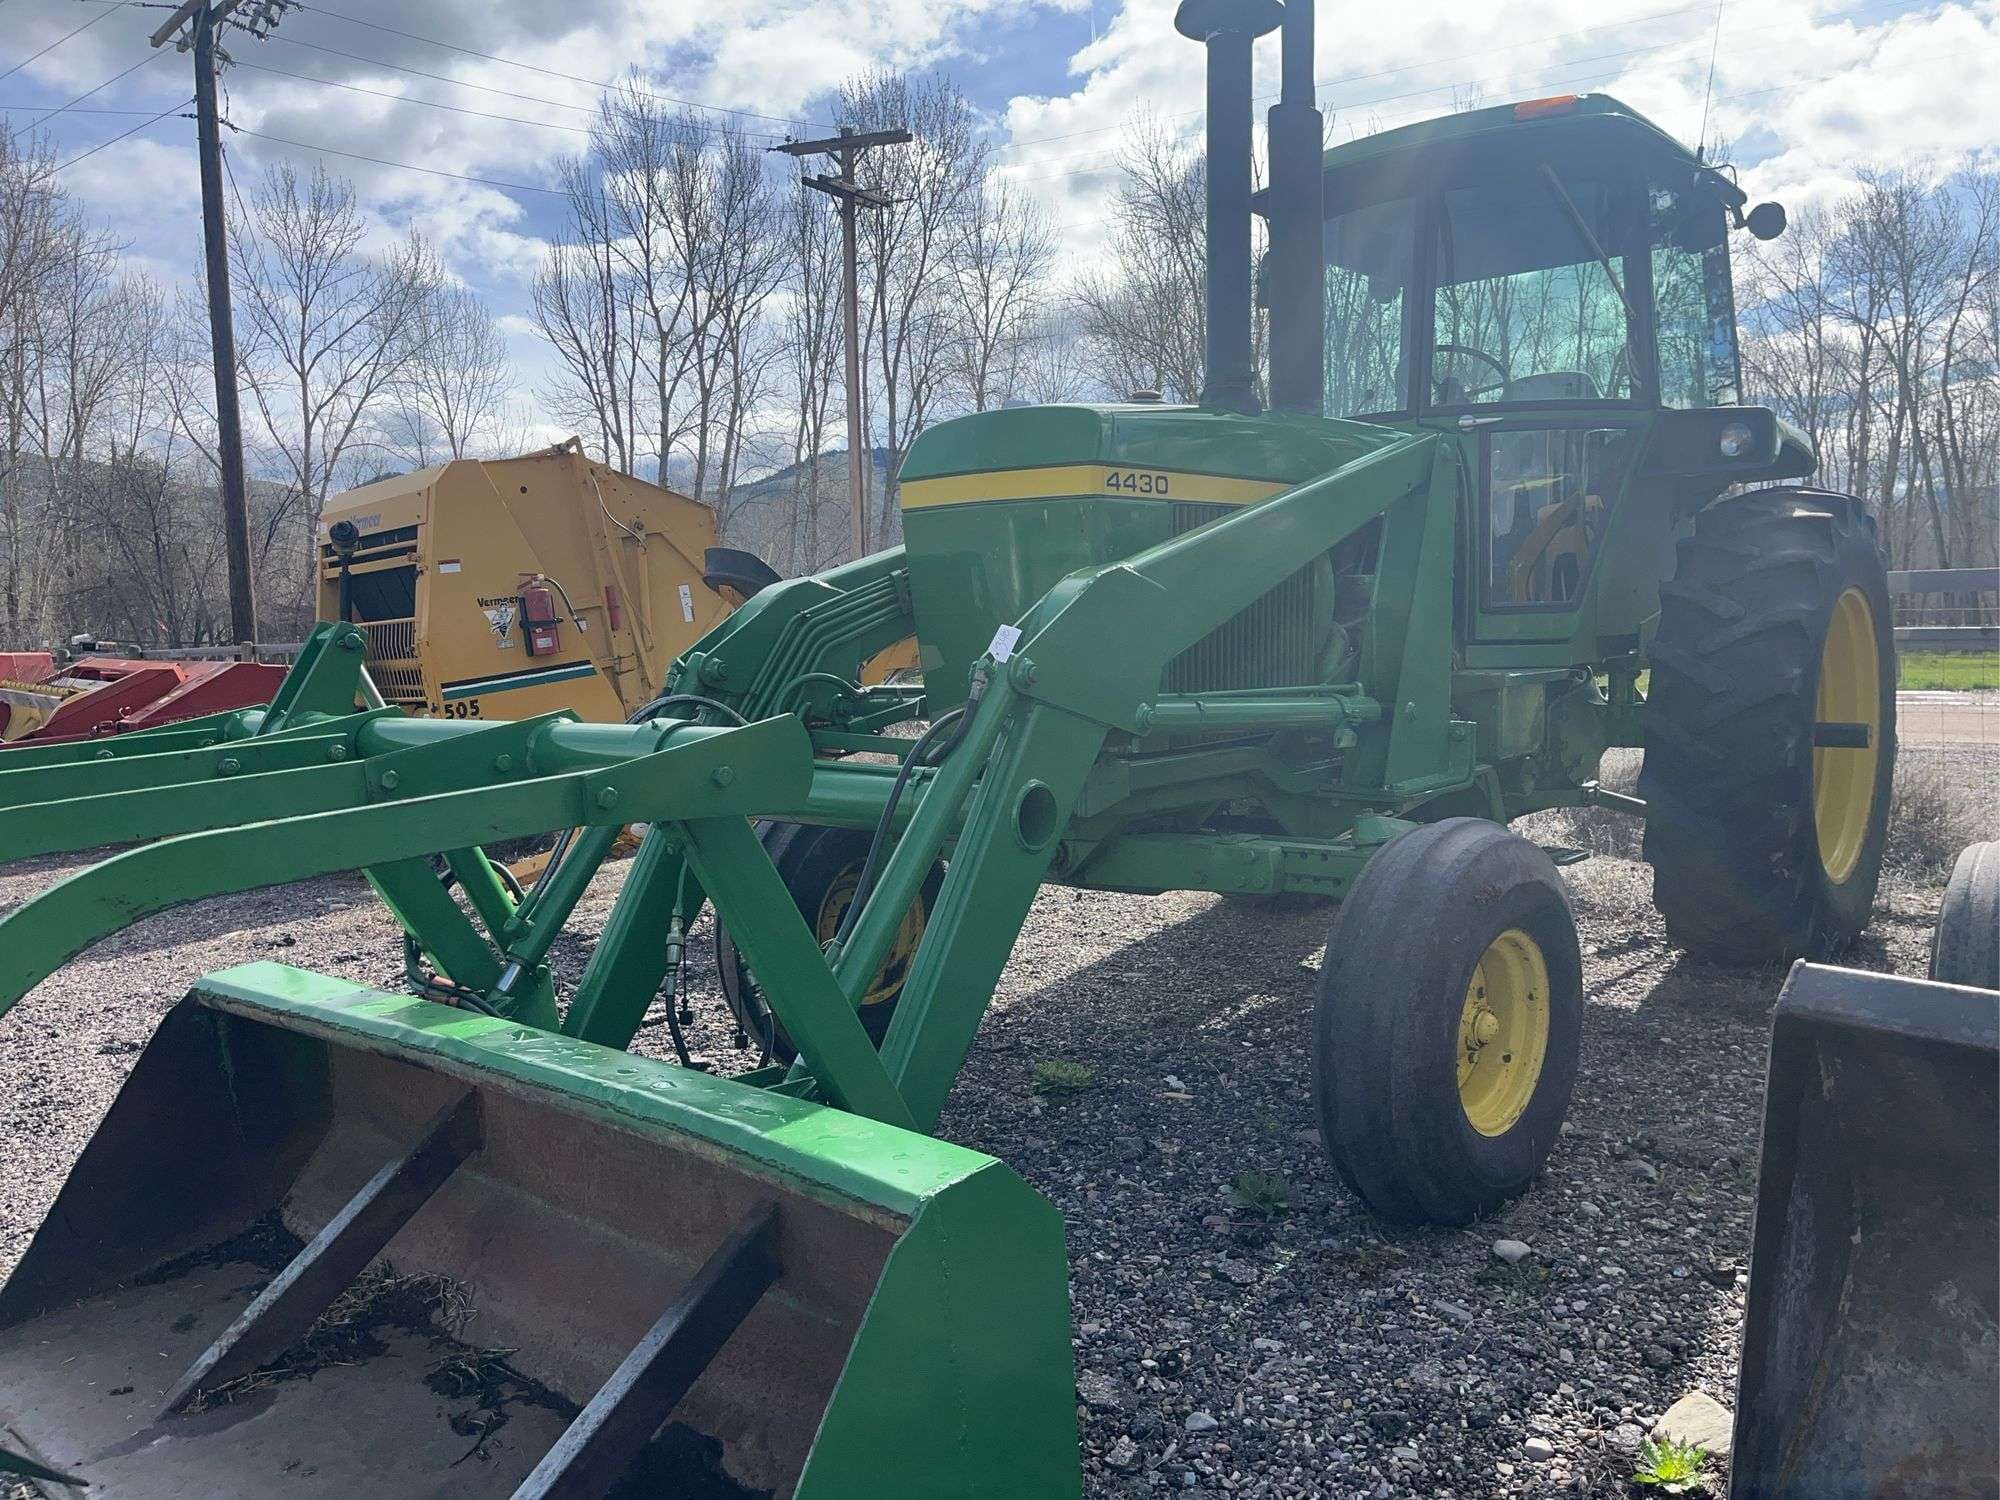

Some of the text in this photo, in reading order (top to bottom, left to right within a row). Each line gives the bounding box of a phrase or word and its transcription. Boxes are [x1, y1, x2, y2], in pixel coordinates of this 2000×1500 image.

[1106, 472, 1168, 494] 4430
[477, 596, 519, 607] Vermeer
[445, 699, 480, 719] 505
